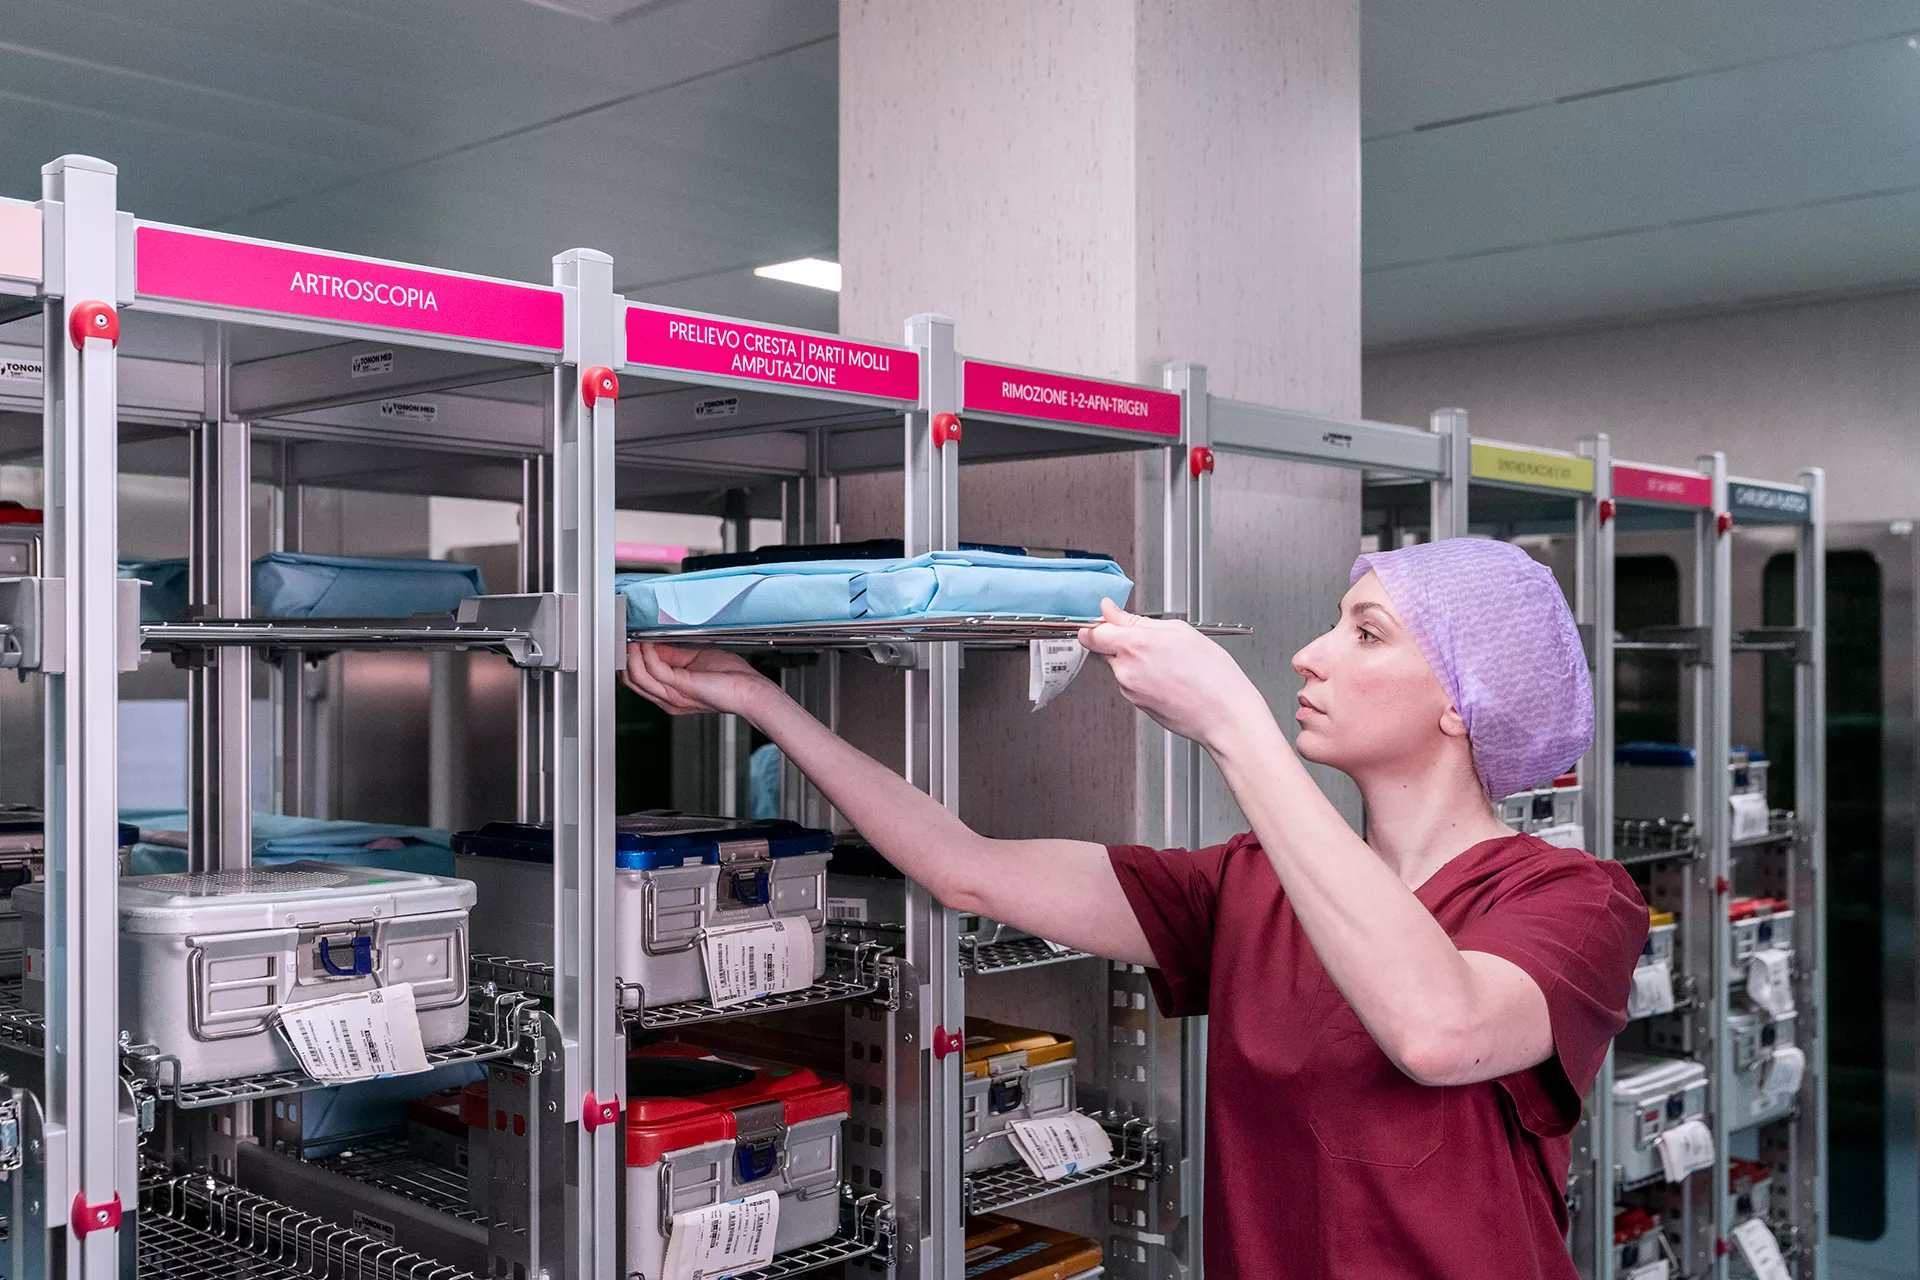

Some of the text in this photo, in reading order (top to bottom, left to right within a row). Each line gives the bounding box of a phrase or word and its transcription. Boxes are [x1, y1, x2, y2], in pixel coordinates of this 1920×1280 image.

[289, 271, 438, 312] ARTROSCOPIA
[669, 320, 740, 349] PRELIEVO
[743, 333, 797, 358] CRESTA
[808, 343, 845, 365] PARTI
[848, 349, 889, 372] MOLLI
[6, 362, 42, 373] TONON
[360, 352, 393, 365] TONON MED
[731, 353, 836, 385] AMPUTAZIONE
[393, 403, 436, 414] TONON MED
[1001, 381, 1149, 417] RIMOZIONE 1-2-AFN-TRIGEN
[361, 1216, 382, 1231] TONON
